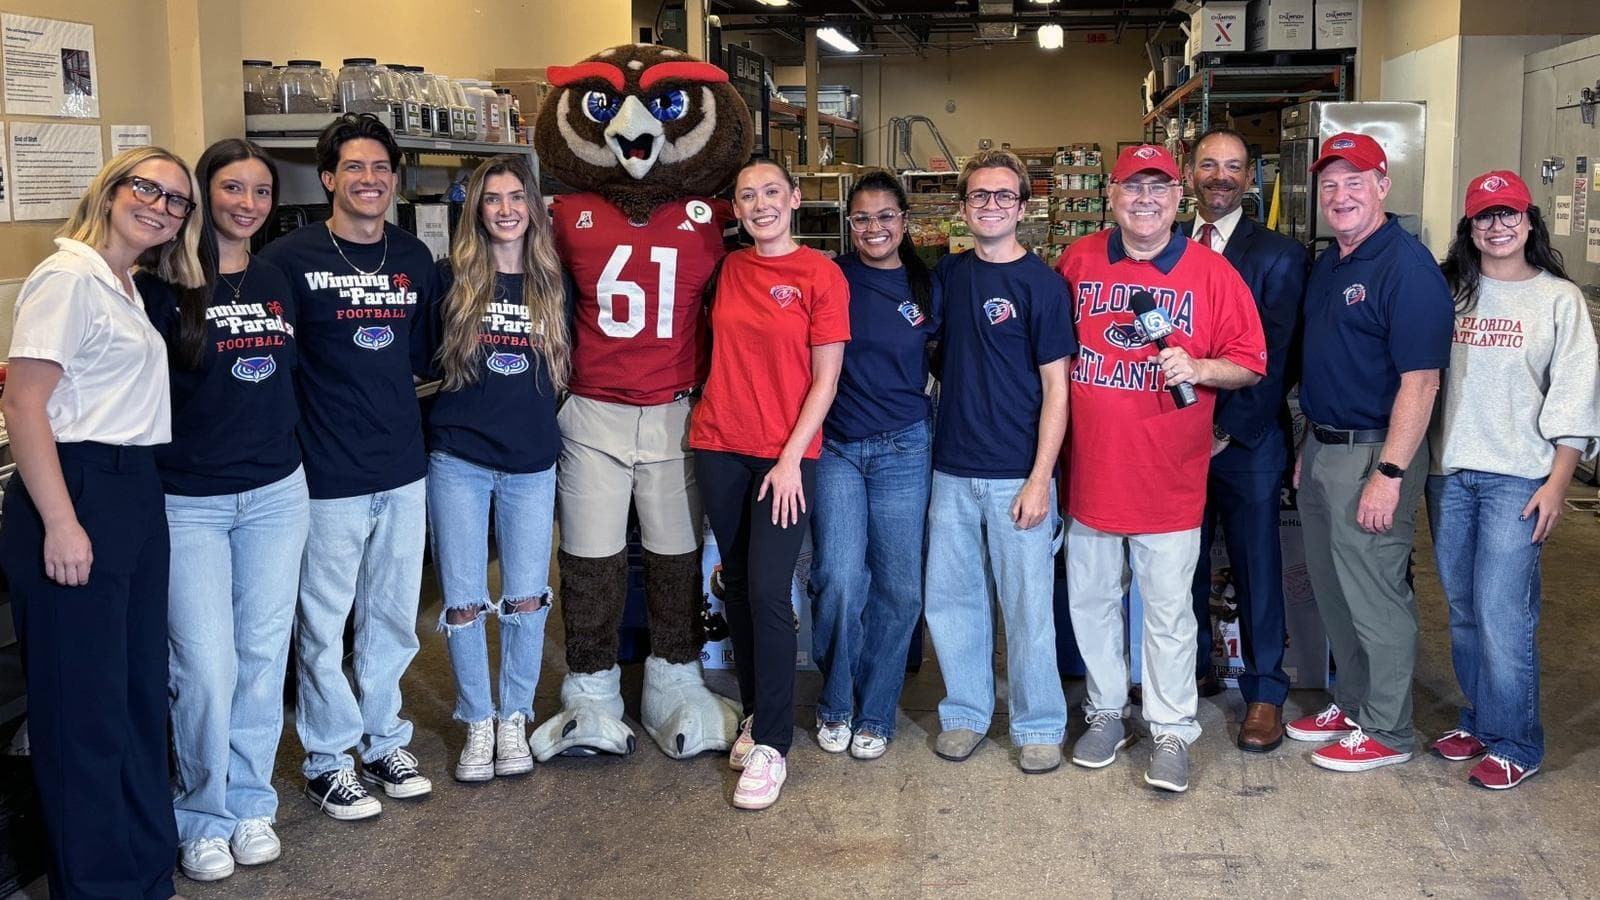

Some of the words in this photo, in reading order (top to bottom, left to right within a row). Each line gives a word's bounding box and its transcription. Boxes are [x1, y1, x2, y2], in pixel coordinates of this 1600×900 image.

[304, 271, 390, 290] Winning
[339, 288, 351, 297] in
[597, 245, 677, 338] 61
[336, 308, 407, 320] FOOTBALL
[1074, 281, 1194, 337] FLODA
[215, 318, 230, 328] in
[1461, 316, 1523, 333] FLORIDA
[1452, 329, 1524, 348] ATLANTIC
[1071, 346, 1171, 392] ATLANT
